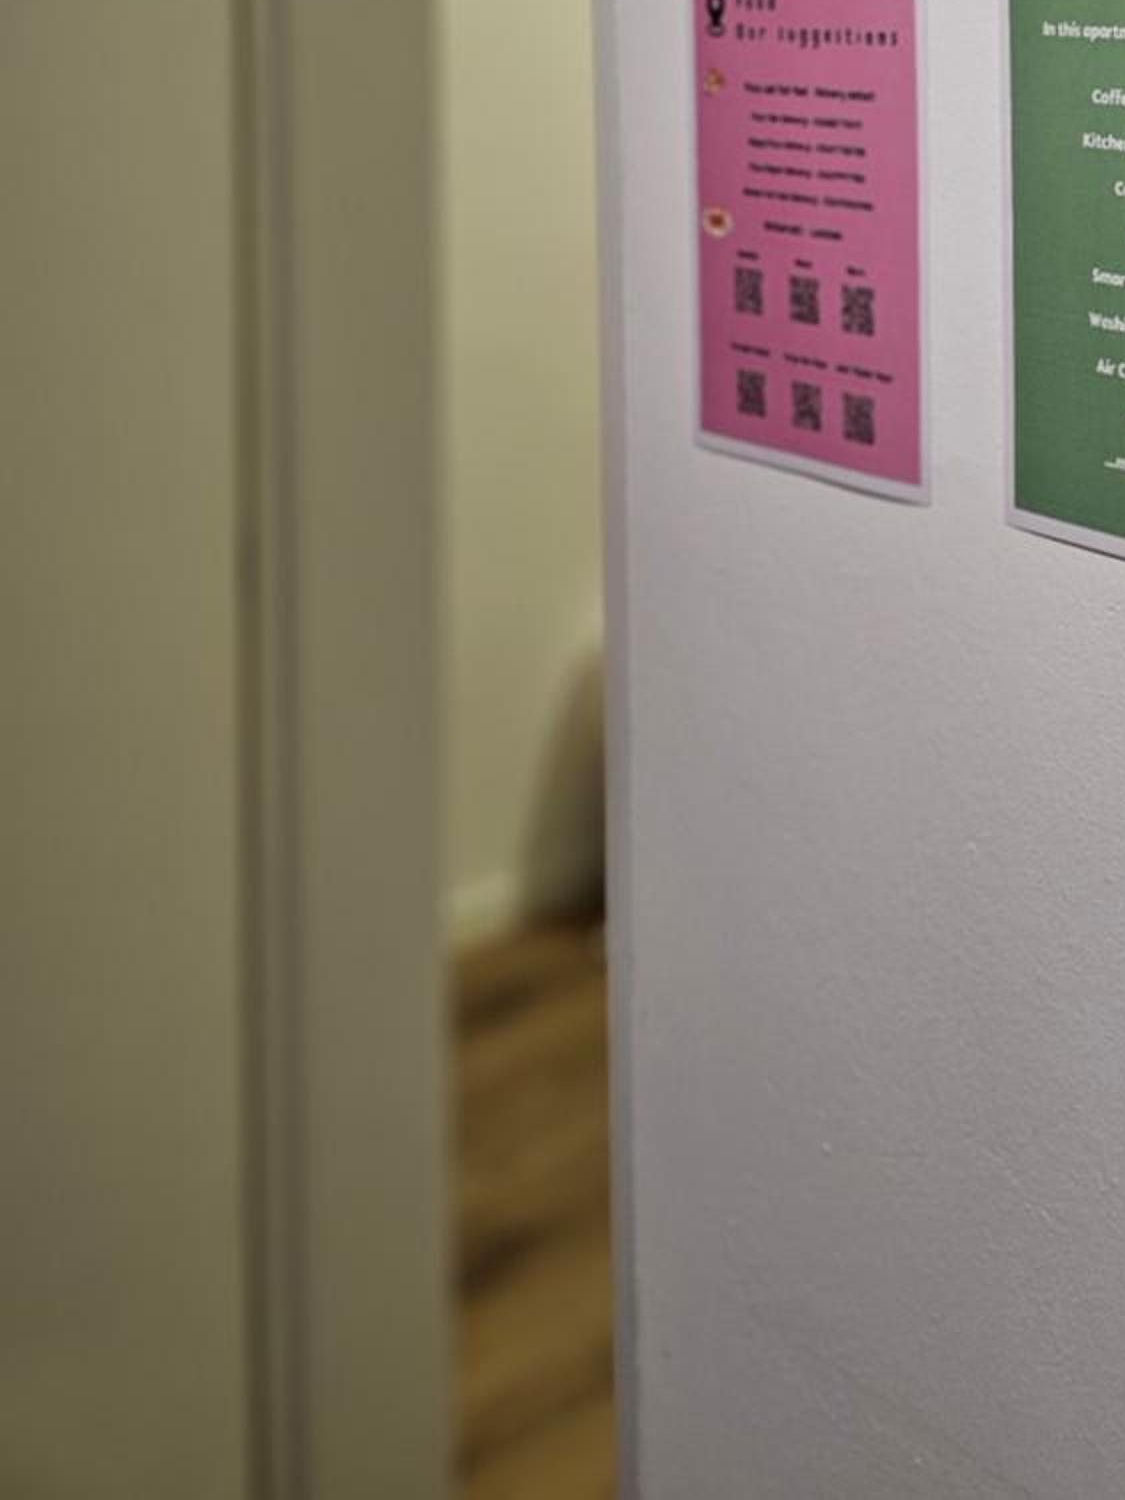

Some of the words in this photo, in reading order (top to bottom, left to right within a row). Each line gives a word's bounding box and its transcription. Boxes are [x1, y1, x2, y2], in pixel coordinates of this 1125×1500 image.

[1043, 21, 1057, 37] In
[1058, 21, 1081, 37] this
[1096, 358, 1115, 375] Air
